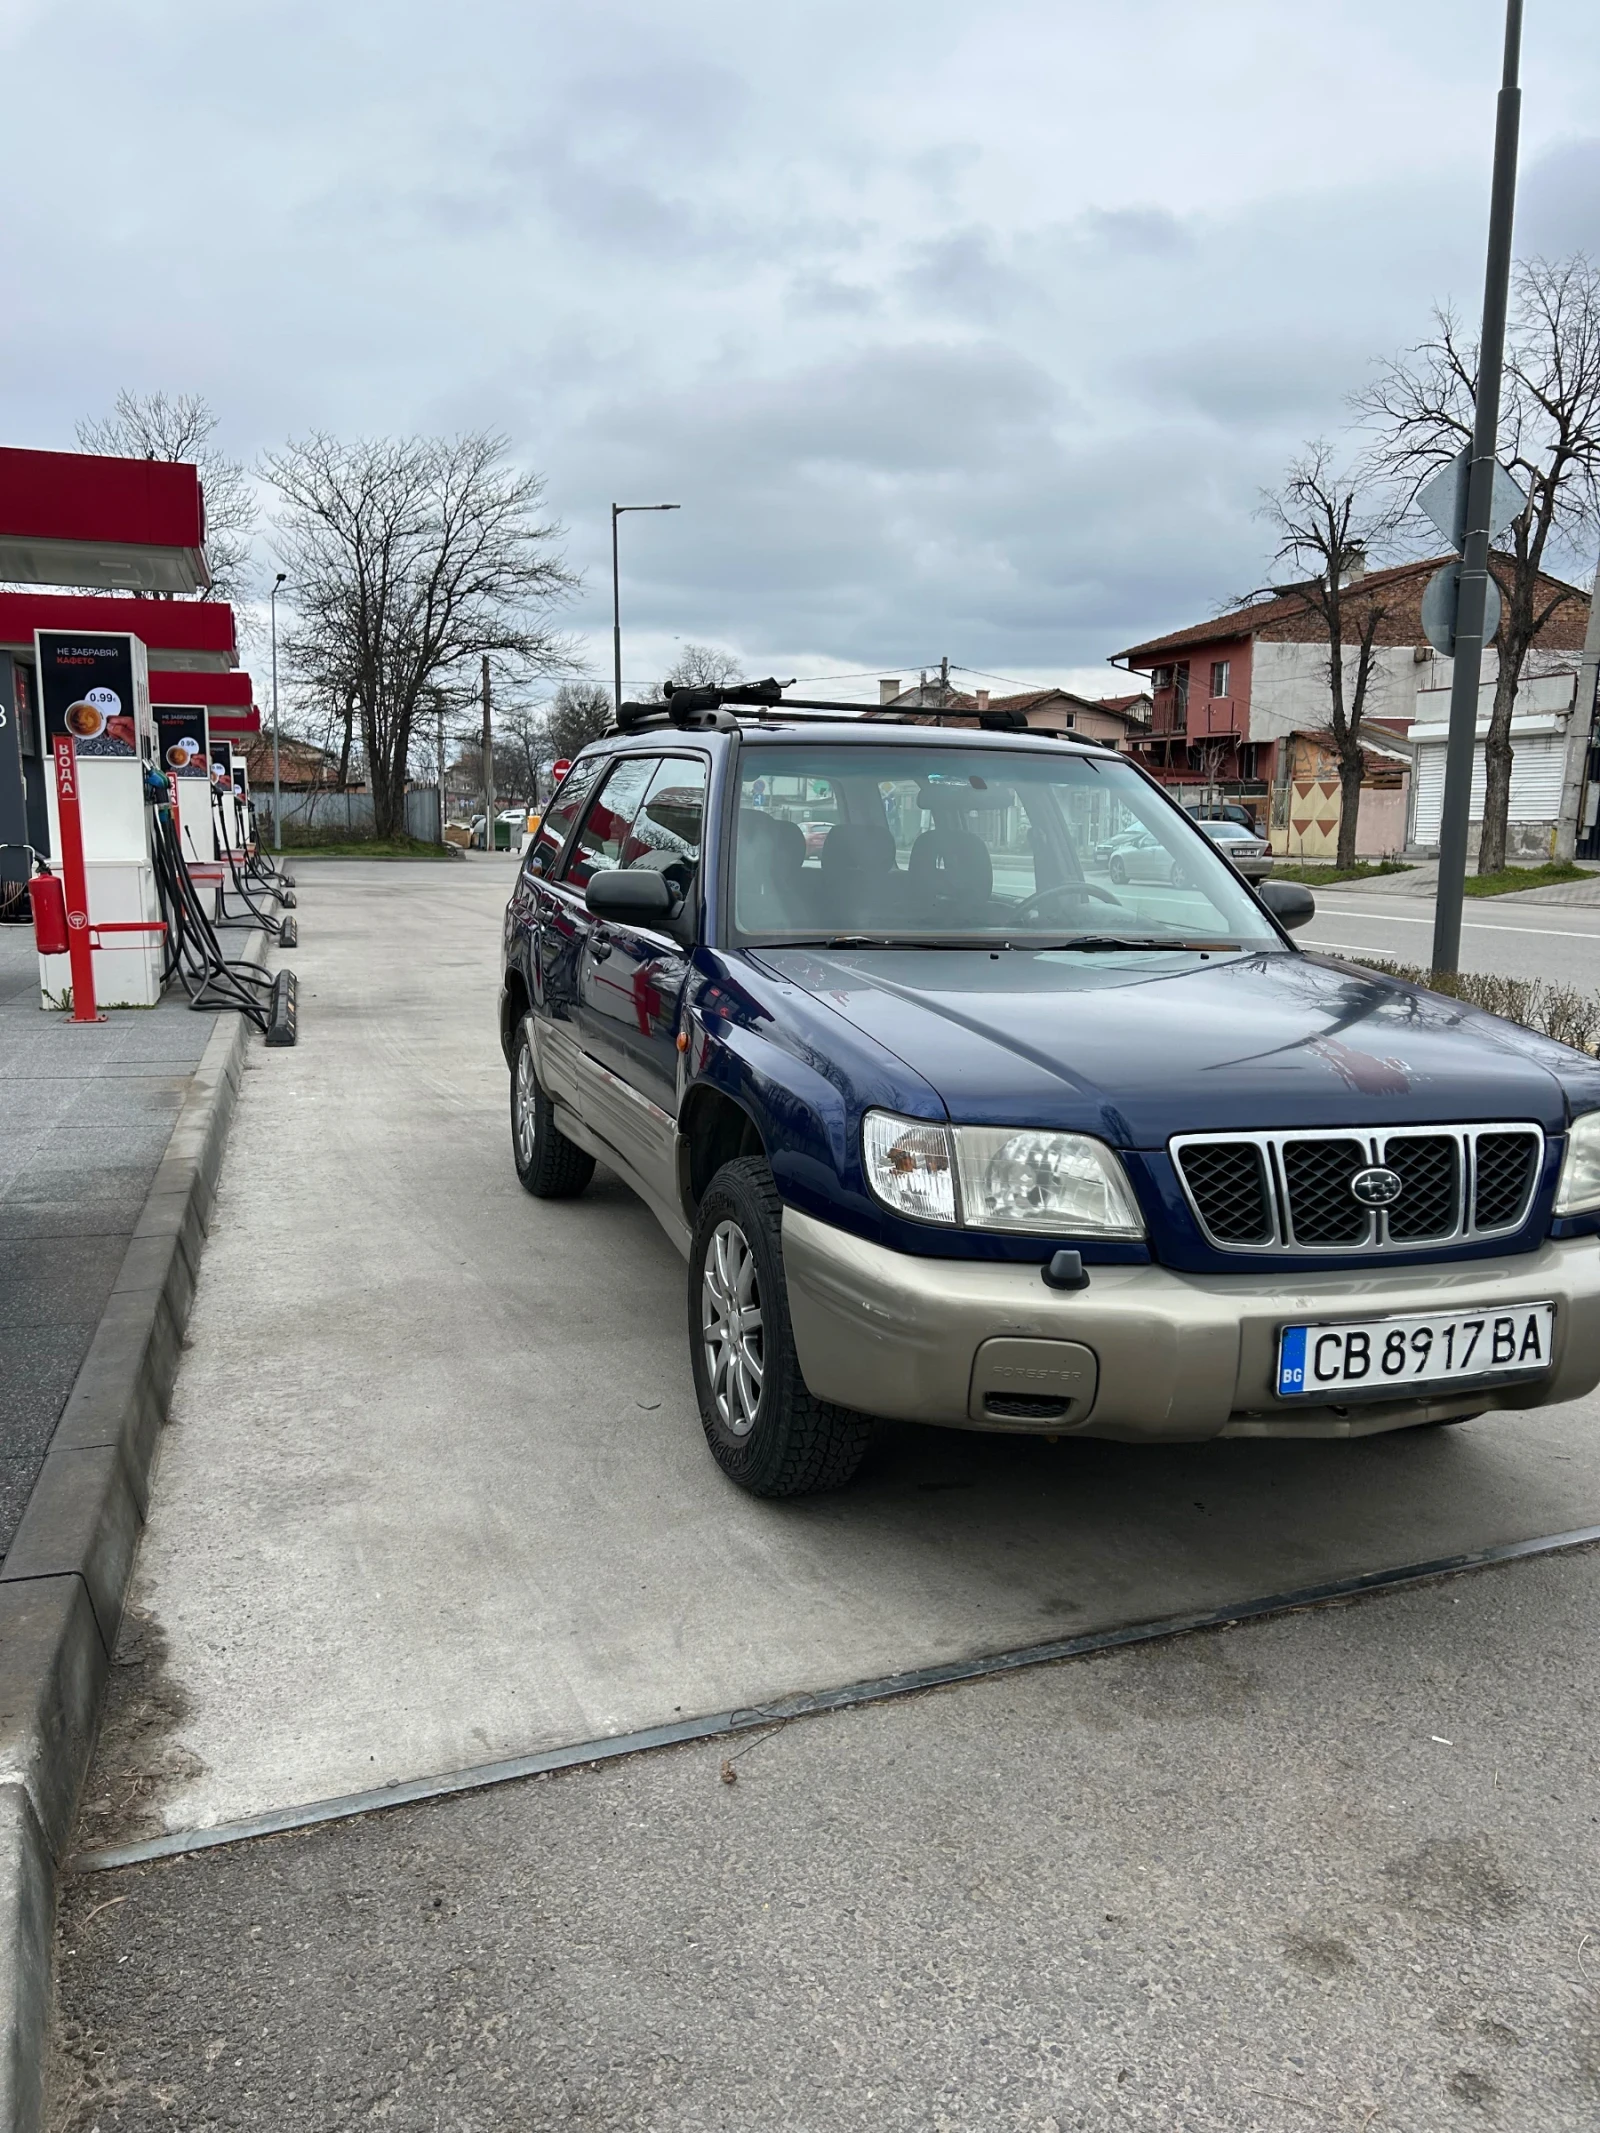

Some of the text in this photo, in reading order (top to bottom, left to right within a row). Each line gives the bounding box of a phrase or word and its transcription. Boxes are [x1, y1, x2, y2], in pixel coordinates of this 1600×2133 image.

[57, 647, 119, 657] НЕ ЗАБРАВЯЙ
[56, 657, 95, 665] КАФЕТО
[59, 744, 74, 793] ВОДА
[1314, 1314, 1542, 1381] CB 8917 BA
[992, 1366, 1082, 1382] FORESTER
[1283, 1368, 1303, 1383] BG
